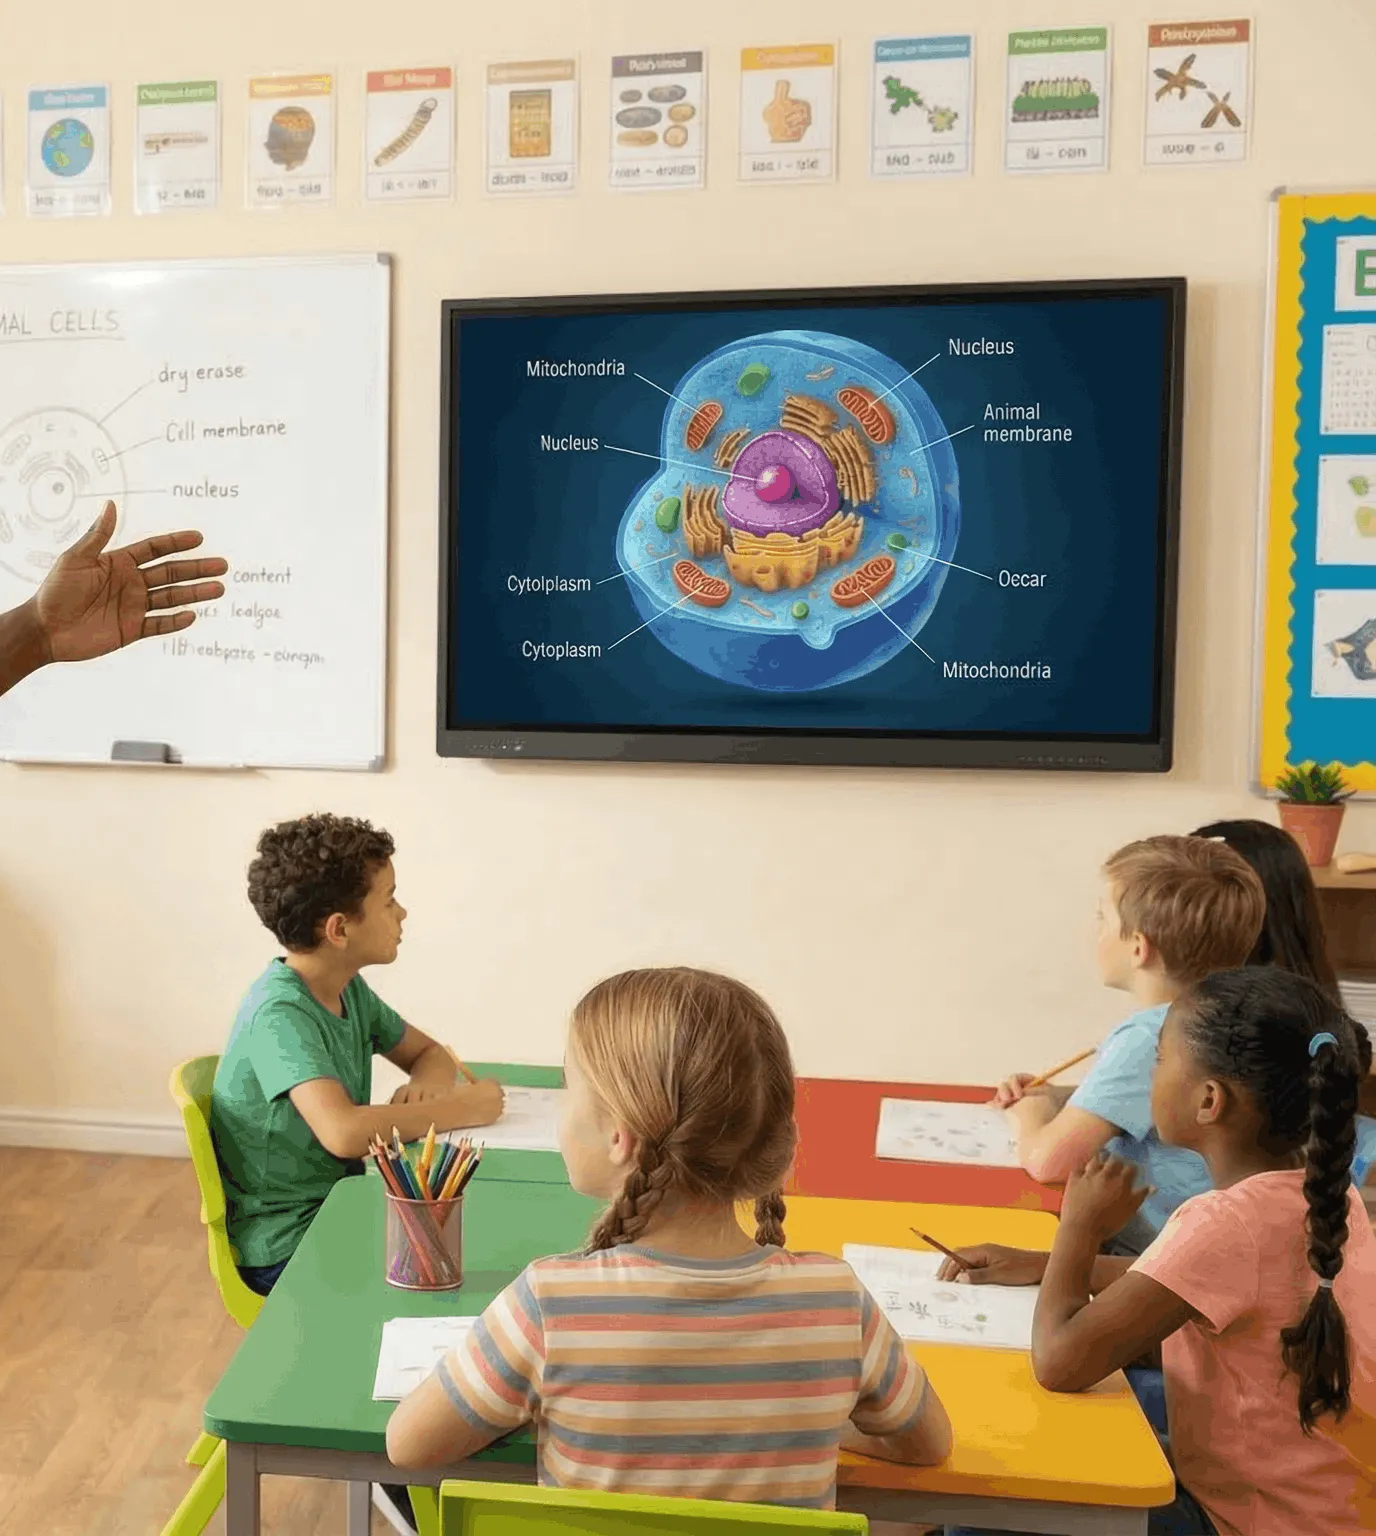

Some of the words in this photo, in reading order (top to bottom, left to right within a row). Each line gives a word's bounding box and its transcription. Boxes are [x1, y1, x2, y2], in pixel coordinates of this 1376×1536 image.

[49, 310, 120, 334] CELLS
[948, 336, 1015, 355] Nucleus
[526, 358, 625, 377] Mitochondria
[158, 362, 189, 394] dry
[195, 366, 245, 380] erase
[984, 402, 1040, 420] Animal
[166, 420, 195, 443] Cell
[202, 416, 287, 439] membrane
[984, 424, 1073, 442] membrane
[541, 435, 599, 452] Nucleus
[172, 479, 239, 498] nucleus
[232, 566, 293, 584] content
[998, 569, 1048, 587] Oecar
[507, 575, 591, 596] Cytolplasm
[522, 640, 601, 662] Cytoplasm
[943, 660, 1051, 679] Mitochondria
